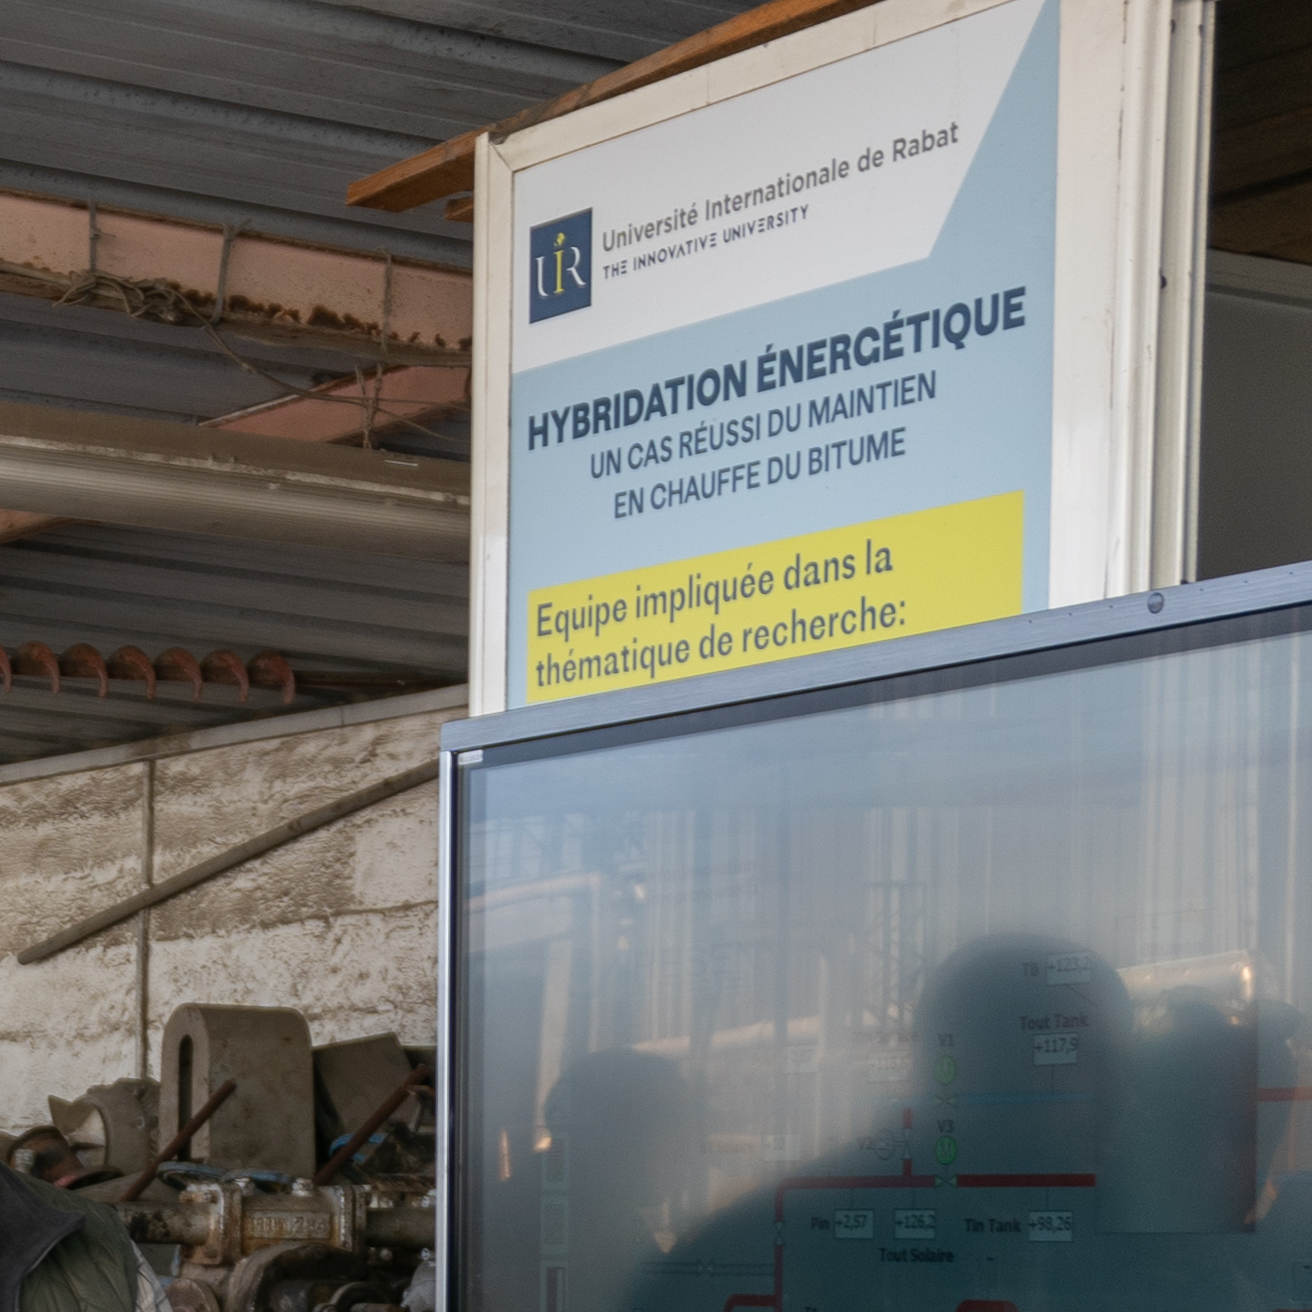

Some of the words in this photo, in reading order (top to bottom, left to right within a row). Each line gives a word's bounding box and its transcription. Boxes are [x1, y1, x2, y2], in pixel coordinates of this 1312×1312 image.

[602, 202, 698, 253] Université
[706, 158, 850, 221] Internationale
[857, 147, 885, 173] de
[892, 121, 960, 163] Rabat
[535, 233, 587, 297] UIR
[603, 260, 628, 280] THE
[633, 232, 718, 271] INNOVATIVE
[723, 203, 810, 244] UNIVERSITY
[527, 361, 748, 451] HYBRIDATION
[757, 287, 1026, 394] ÉNERGÉTIQUE
[590, 446, 623, 479] UN
[627, 435, 673, 470] CAS
[678, 412, 761, 459] RÉUSSI
[767, 403, 802, 435] DU
[808, 370, 937, 428] MAINTIEN
[614, 486, 645, 519] EN
[650, 460, 761, 511] CHAUFFE
[767, 453, 801, 485] DU
[808, 427, 907, 476] BITUME
[536, 594, 628, 643] Equipe
[635, 562, 775, 624] impliquée
[783, 553, 857, 598] dans
[866, 538, 894, 576] la
[536, 637, 691, 688] thématique
[699, 623, 734, 660] de
[742, 595, 907, 653] recherche:
[1019, 1016, 1051, 1032] Tout
[1055, 1013, 1090, 1030] Tank
[878, 1247, 908, 1263] Tout
[990, 1217, 1022, 1235] Tank
